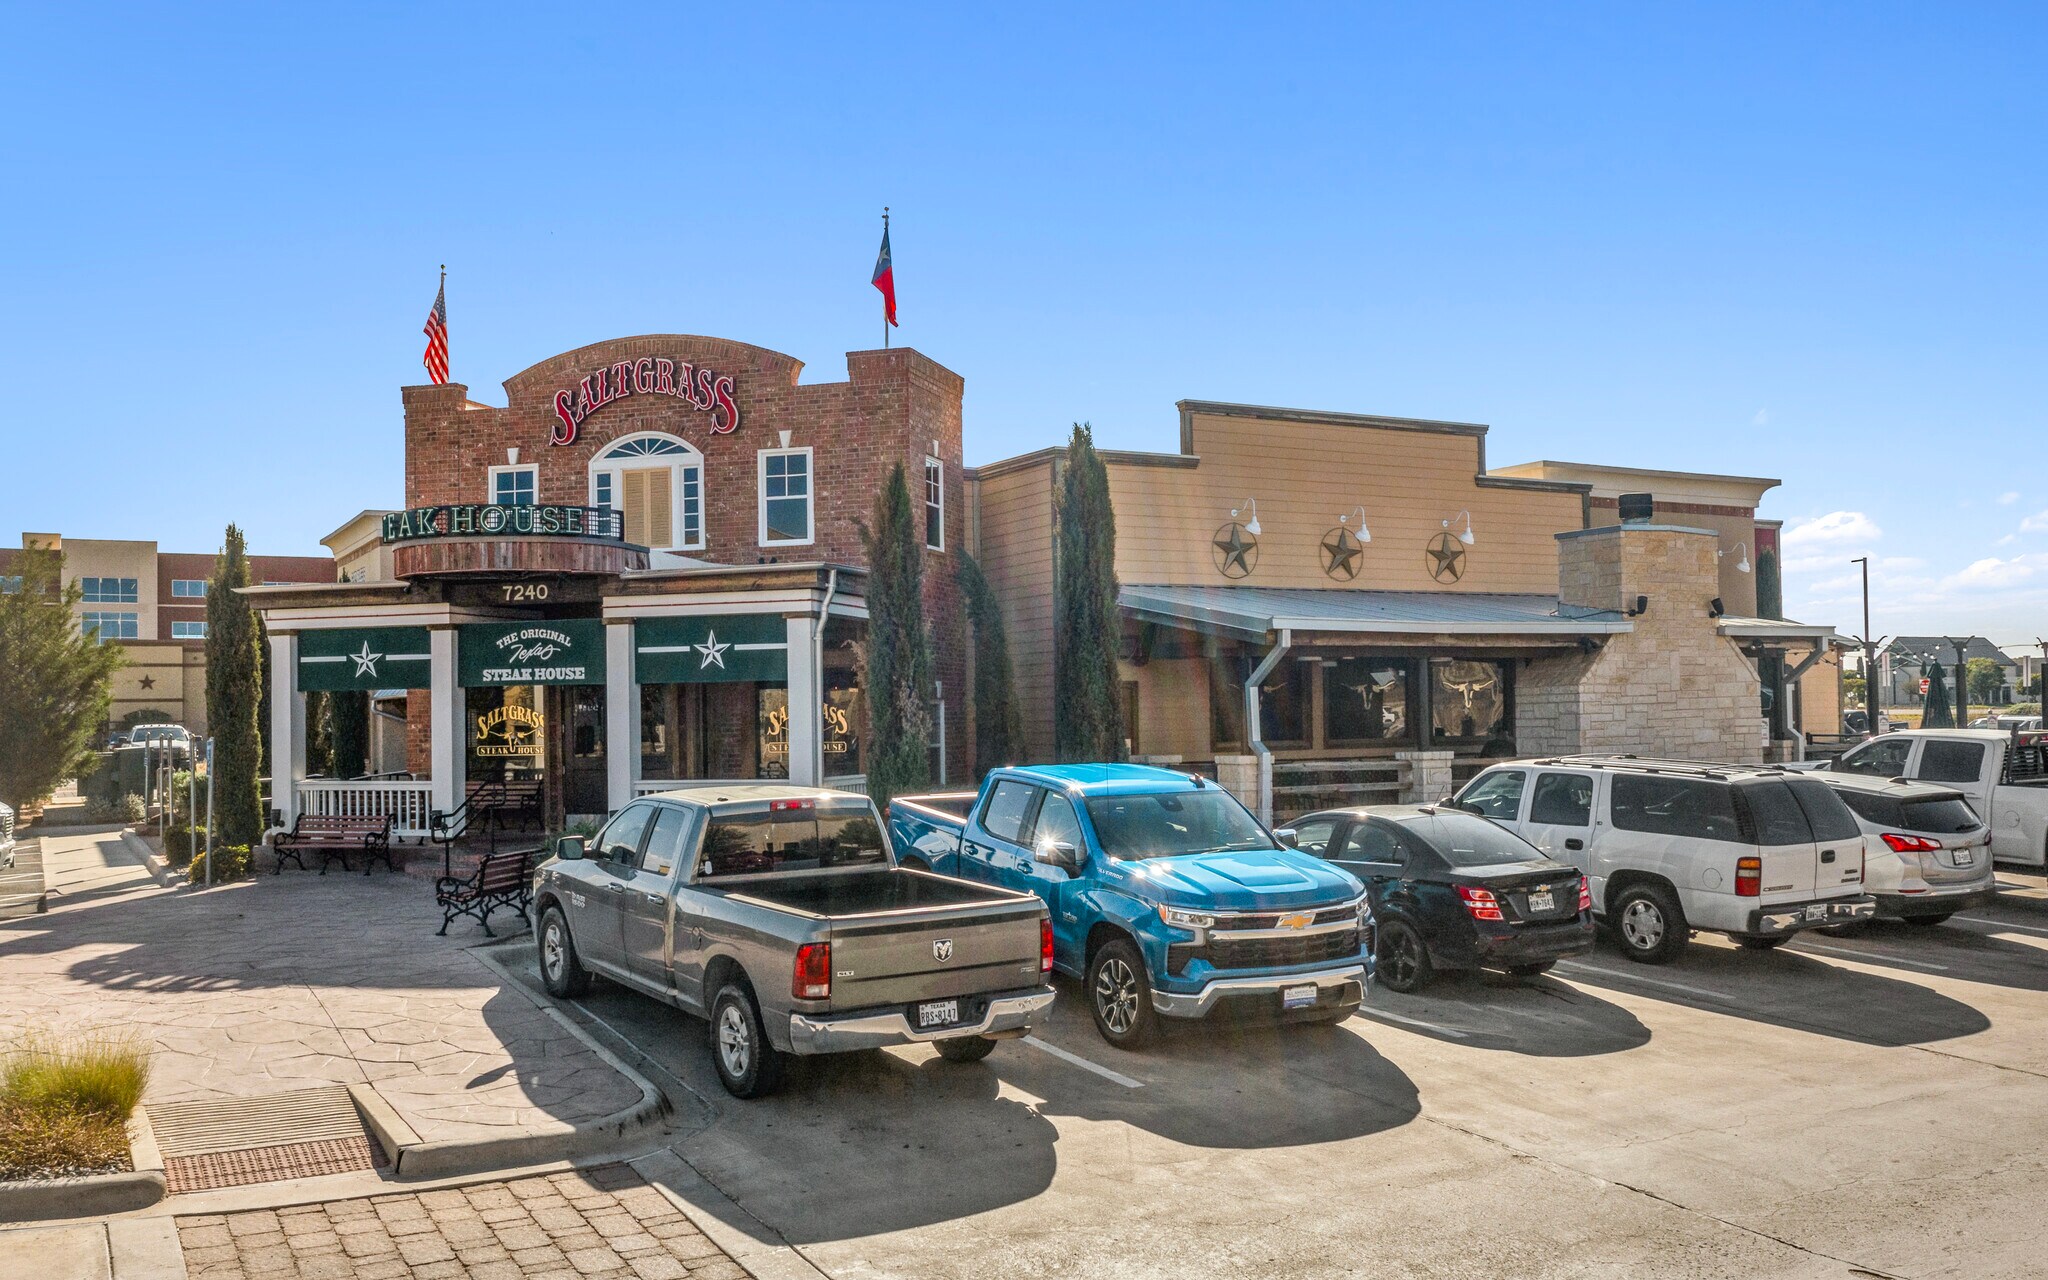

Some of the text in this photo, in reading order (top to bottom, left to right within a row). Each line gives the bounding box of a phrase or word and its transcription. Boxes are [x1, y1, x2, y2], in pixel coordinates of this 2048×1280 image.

[549, 357, 740, 446] SALTGRASS
[383, 506, 583, 542] EAK HOUSE
[502, 584, 548, 601] 7240
[496, 628, 572, 649] THE ORIGINAL
[509, 642, 561, 664] Texas
[482, 667, 585, 682] STEAK HOUSE
